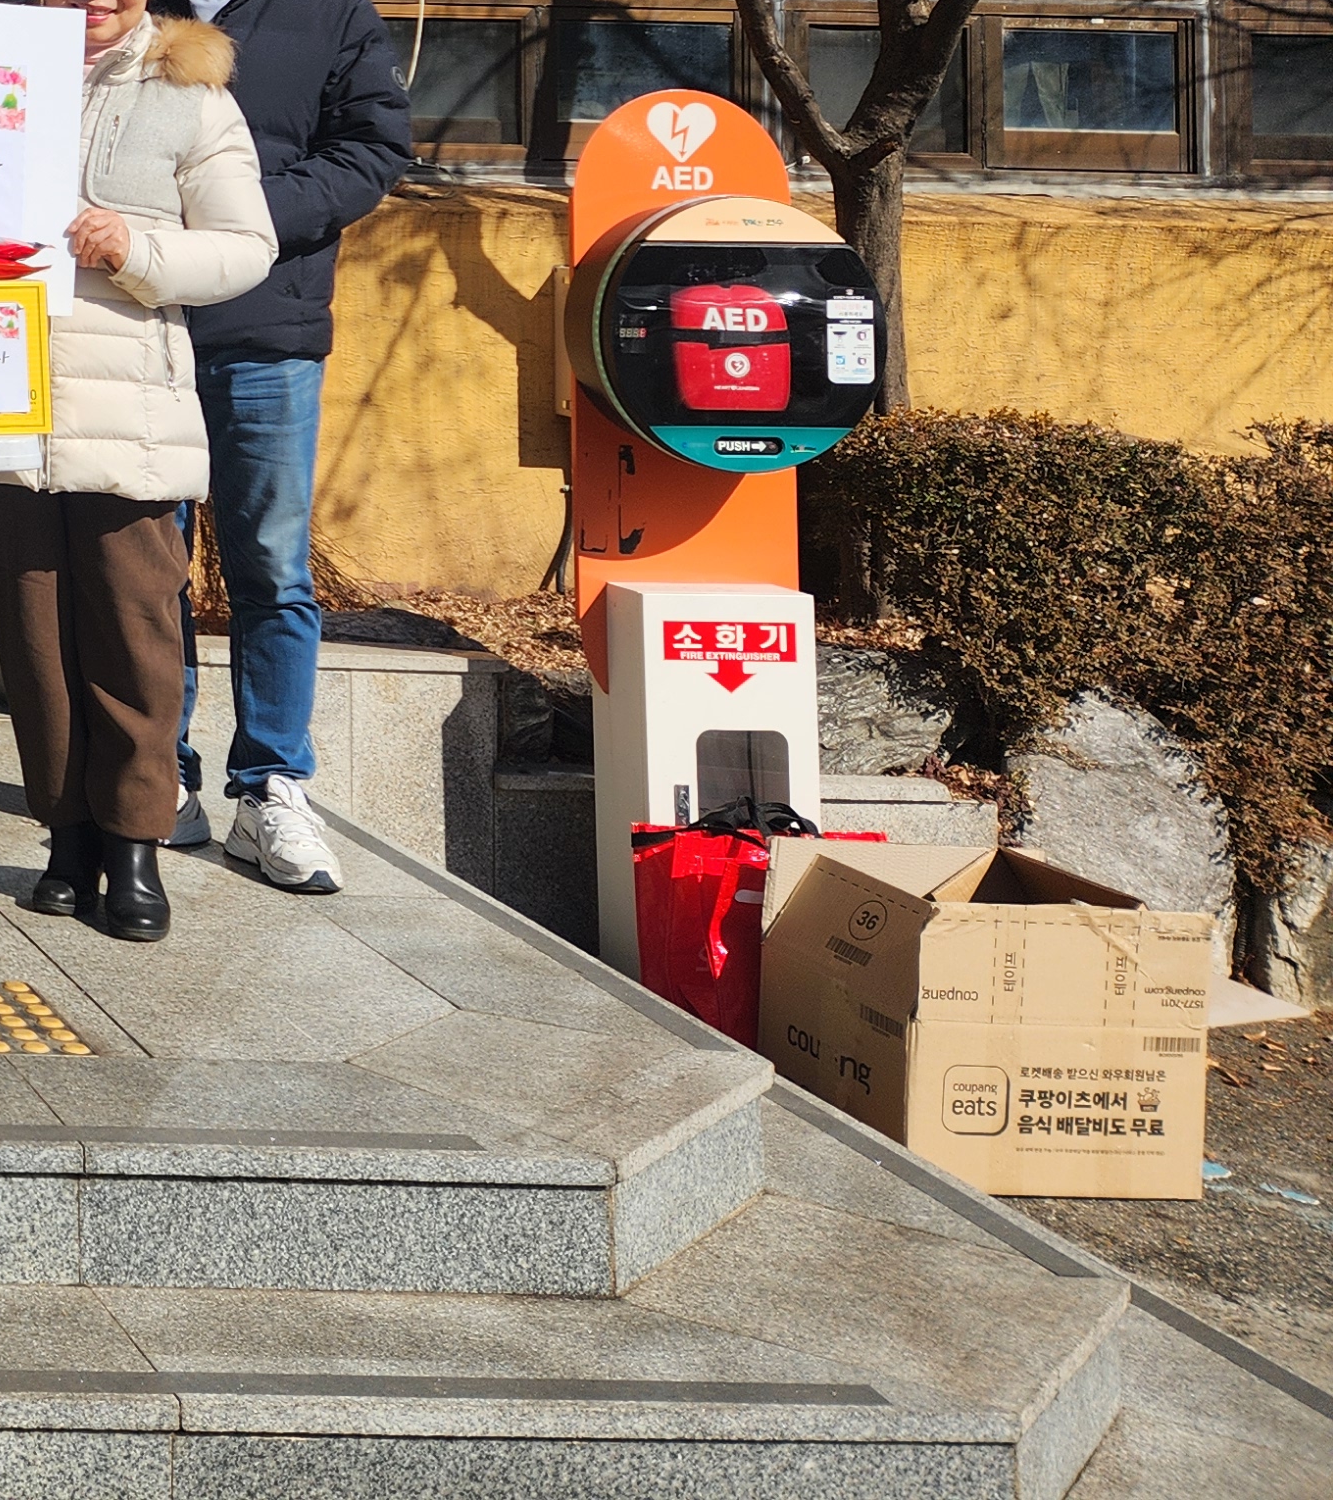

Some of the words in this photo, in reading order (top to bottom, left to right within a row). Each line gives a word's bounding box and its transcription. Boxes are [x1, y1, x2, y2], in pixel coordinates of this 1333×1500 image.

[651, 166, 714, 190] AED
[702, 307, 768, 331] AED
[717, 441, 751, 451] PUSH
[672, 623, 788, 652] 소화기
[680, 651, 704, 660] FIRE
[705, 652, 781, 661] EXTINGUISHER
[856, 910, 880, 931] 36
[1003, 952, 1017, 992] 테이프
[1114, 956, 1128, 996] 테이프
[922, 986, 979, 1002] coupang
[1144, 986, 1206, 997] coupang.com
[1161, 998, 1205, 1009] 1577-7011
[787, 1024, 873, 1096] coung
[1019, 1066, 1064, 1079] 로켓배송
[1067, 1067, 1099, 1081] 받으신
[1102, 1069, 1167, 1083] 와우회원님은
[952, 1081, 998, 1096] coupang
[951, 1096, 998, 1117] eats
[1018, 1089, 1128, 1111] 쿠팡이츠에서
[1017, 1115, 1052, 1135] 음식
[1056, 1116, 1127, 1137] 배달비도
[1130, 1118, 1165, 1138] 무료
